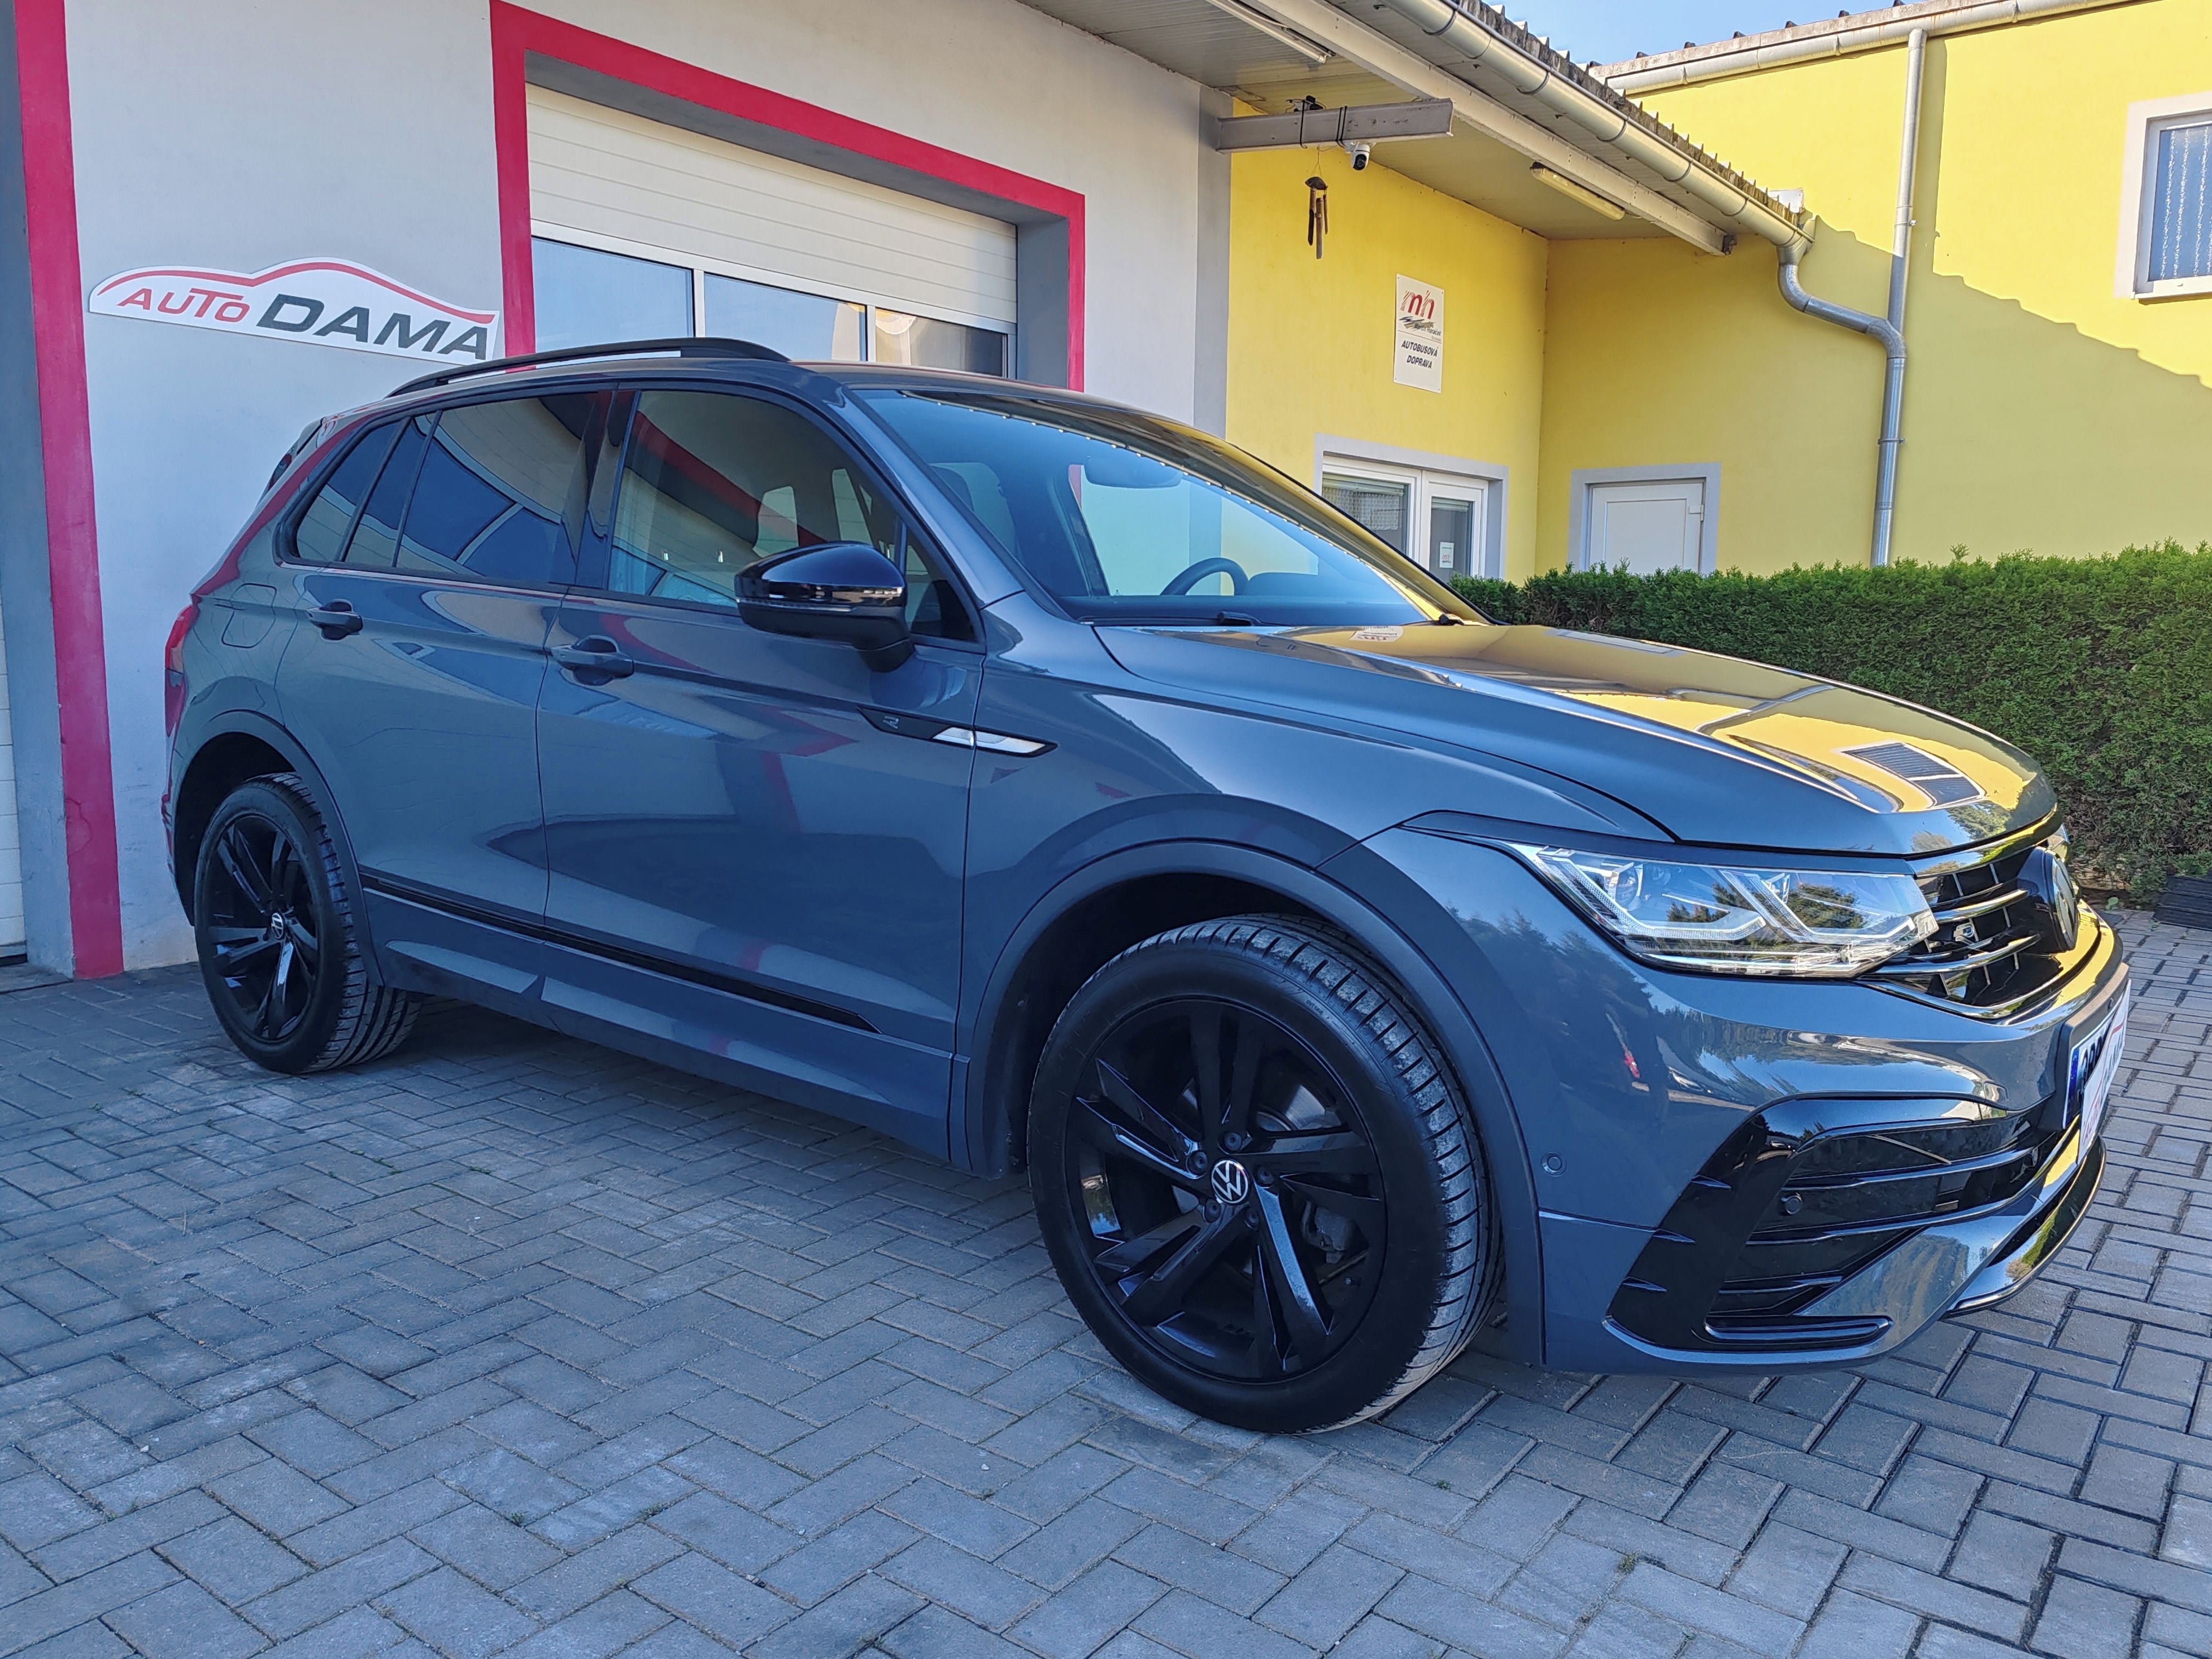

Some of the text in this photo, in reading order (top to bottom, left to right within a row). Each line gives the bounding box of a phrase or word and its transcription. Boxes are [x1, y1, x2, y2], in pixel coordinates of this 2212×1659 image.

[116, 287, 489, 360] AUTO DAMA
[1401, 340, 1438, 358] AUTOBUSOVÁ
[1406, 354, 1433, 369] DOPRAVA
